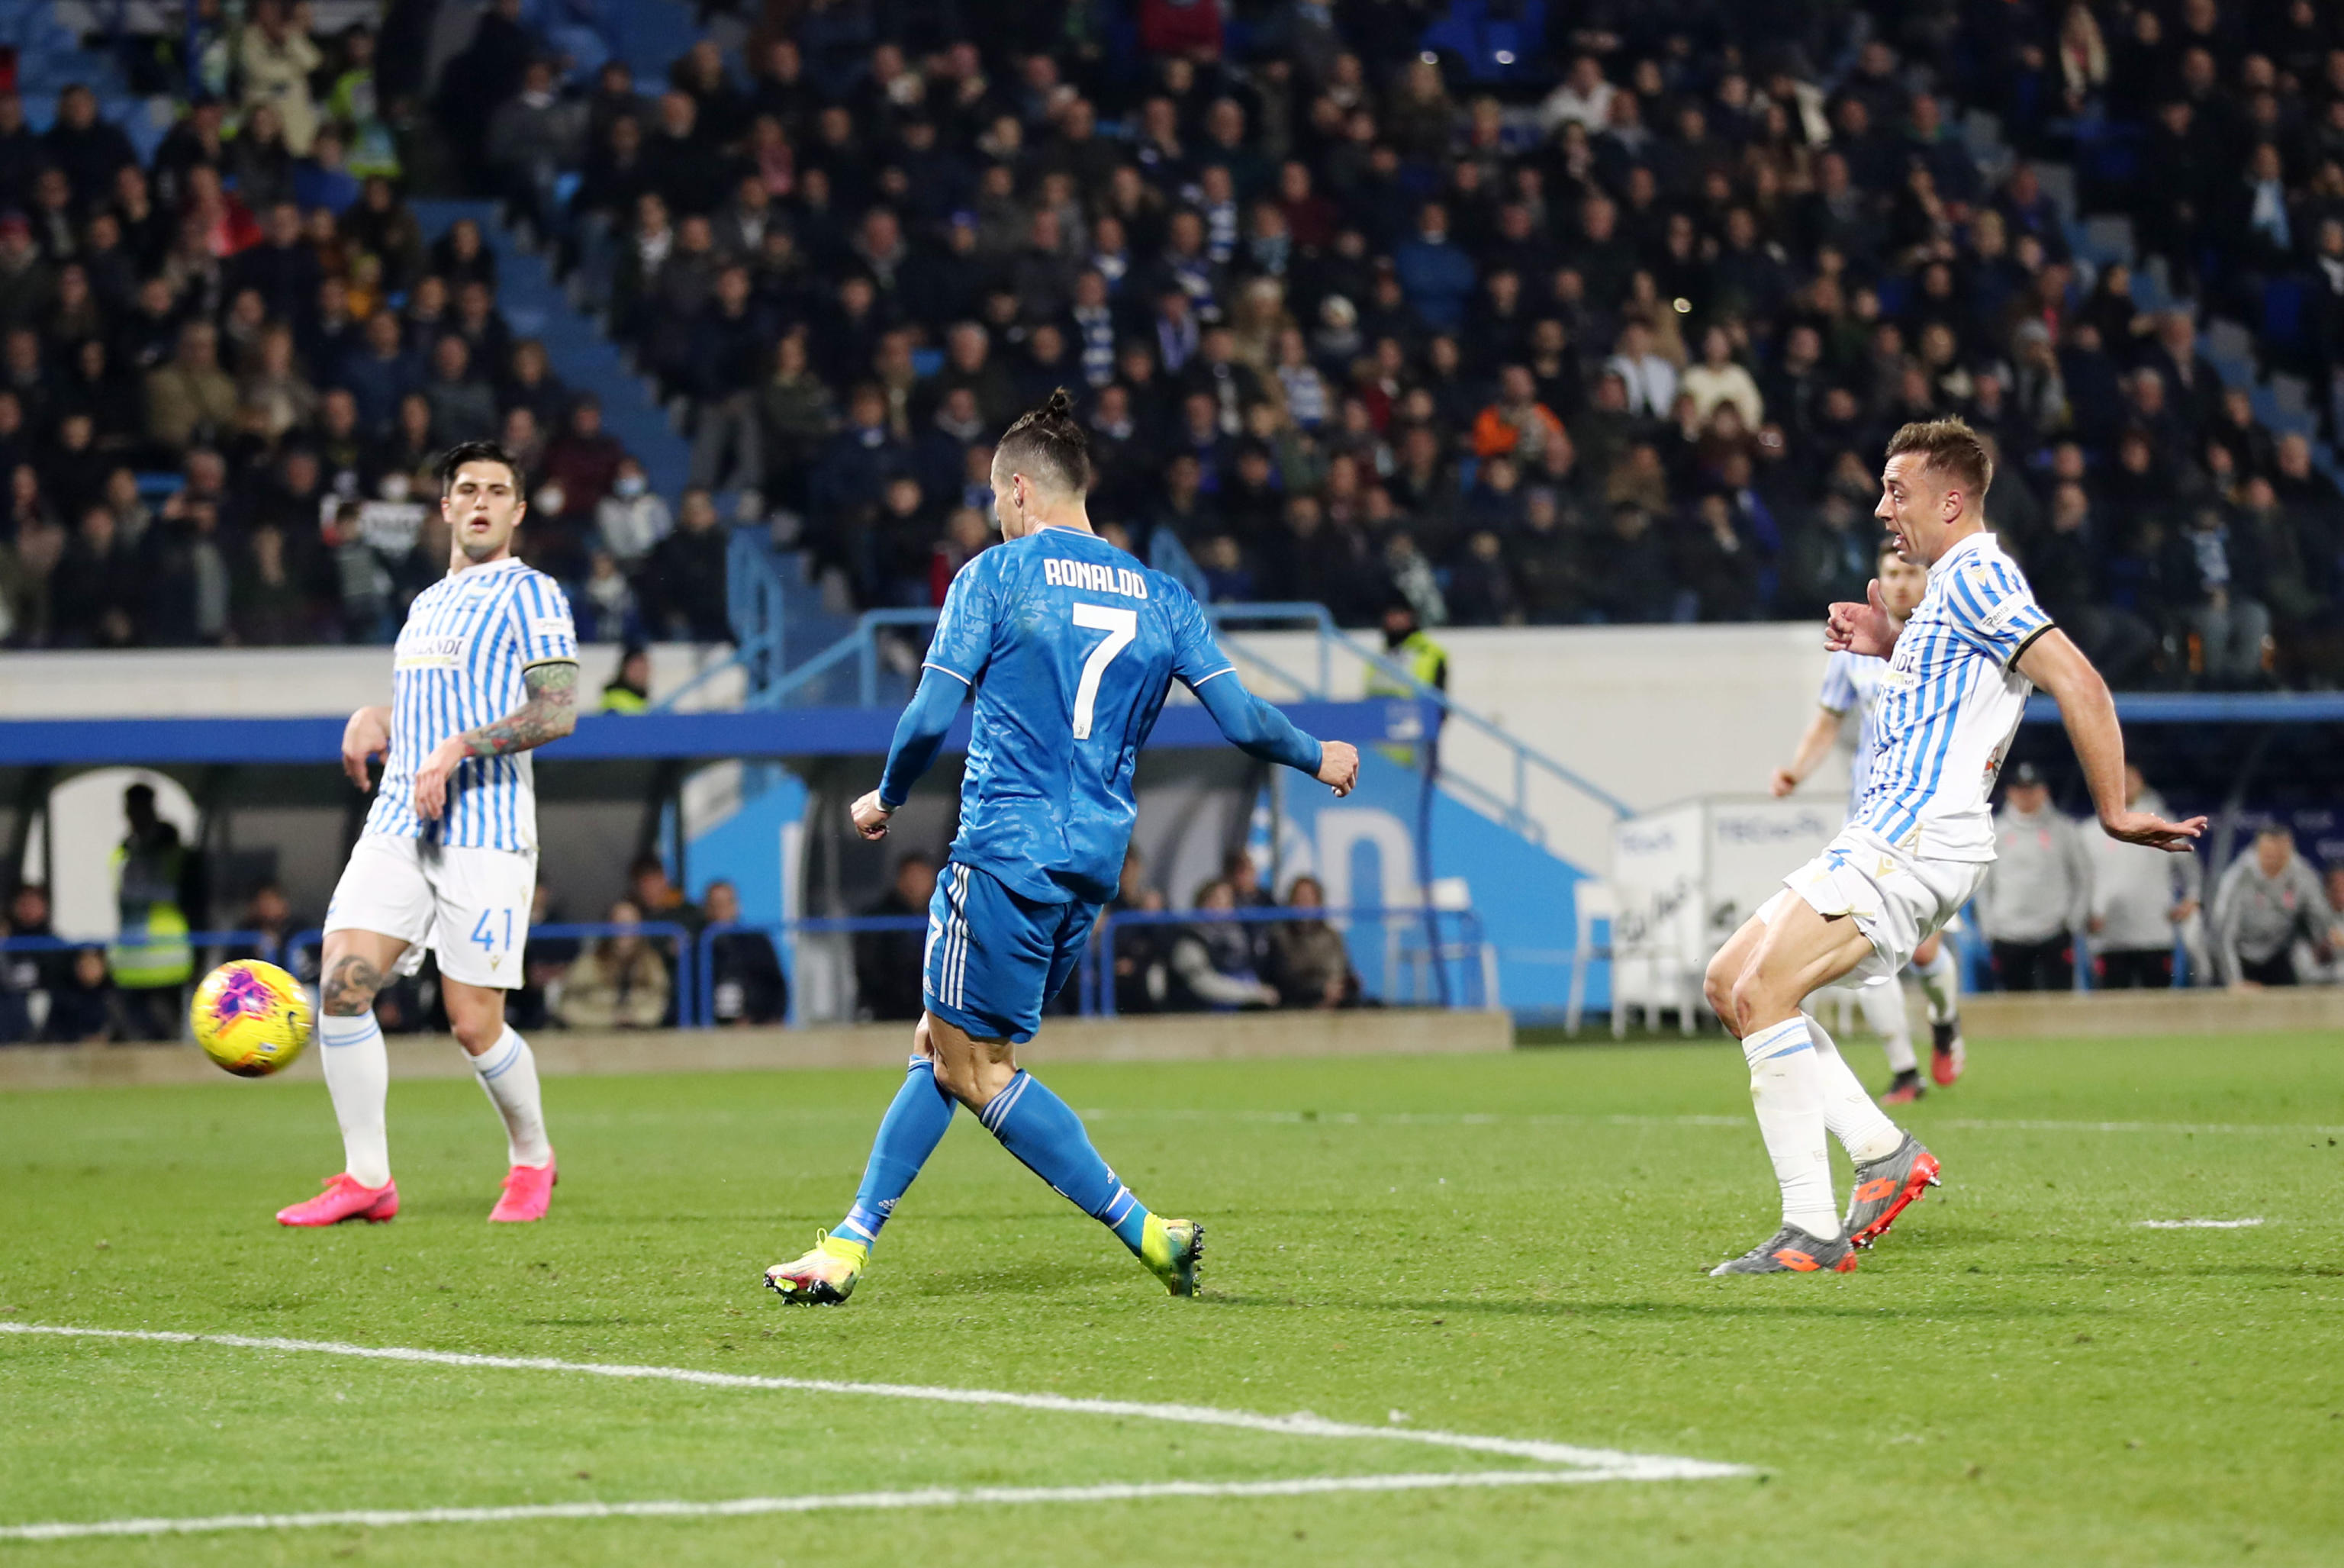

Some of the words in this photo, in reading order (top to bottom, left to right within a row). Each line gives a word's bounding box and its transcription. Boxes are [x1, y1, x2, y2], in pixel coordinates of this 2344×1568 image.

[1043, 558, 1148, 600] RONALDO
[1072, 602, 1137, 740] 7
[470, 907, 513, 952] 41
